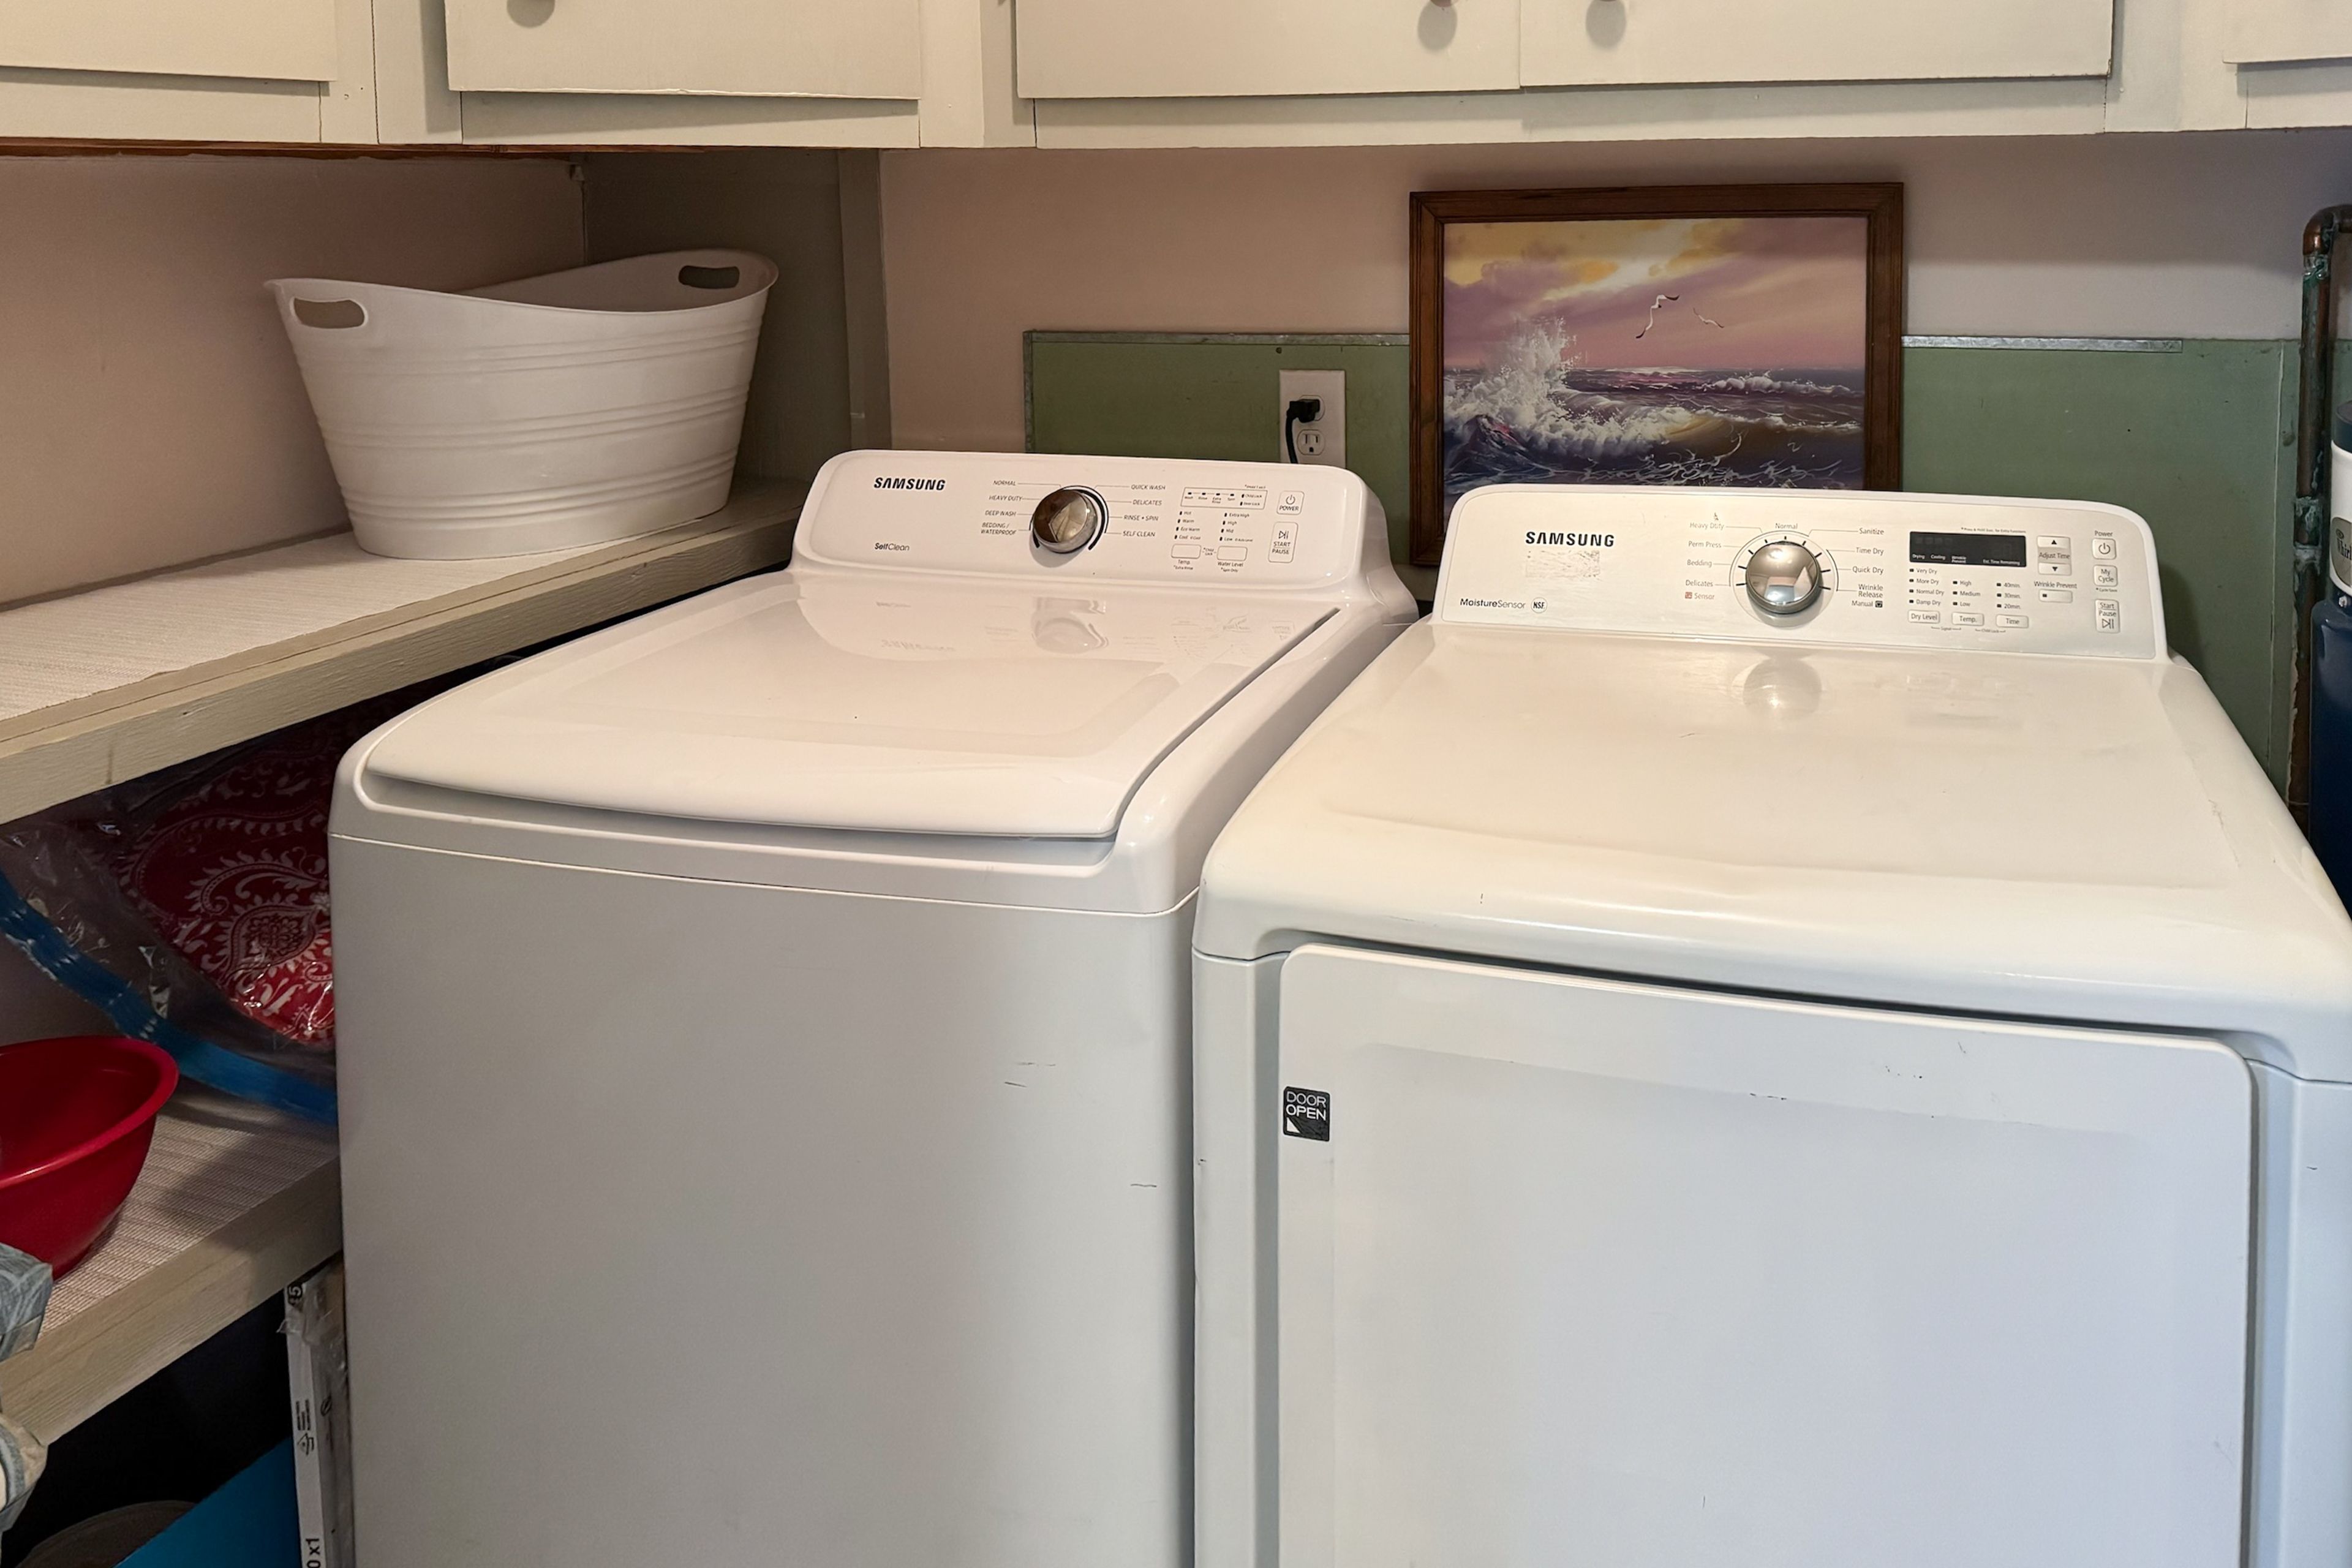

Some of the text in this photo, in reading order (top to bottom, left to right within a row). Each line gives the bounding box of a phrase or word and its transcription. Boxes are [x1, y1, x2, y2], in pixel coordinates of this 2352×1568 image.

[873, 477, 946, 491] SAMSUNG
[1525, 531, 1615, 548] SAMSUNG
[874, 542, 910, 552] SelfClean
[1871, 547, 1884, 556] Dry
[1687, 559, 1713, 568] Bedding
[1872, 567, 1884, 575] Dry
[2098, 575, 2114, 584] Cycle
[1460, 598, 1525, 609] MoistureSensor
[1286, 1091, 1326, 1108] DOOR
[1286, 1104, 1327, 1121] OPEN
